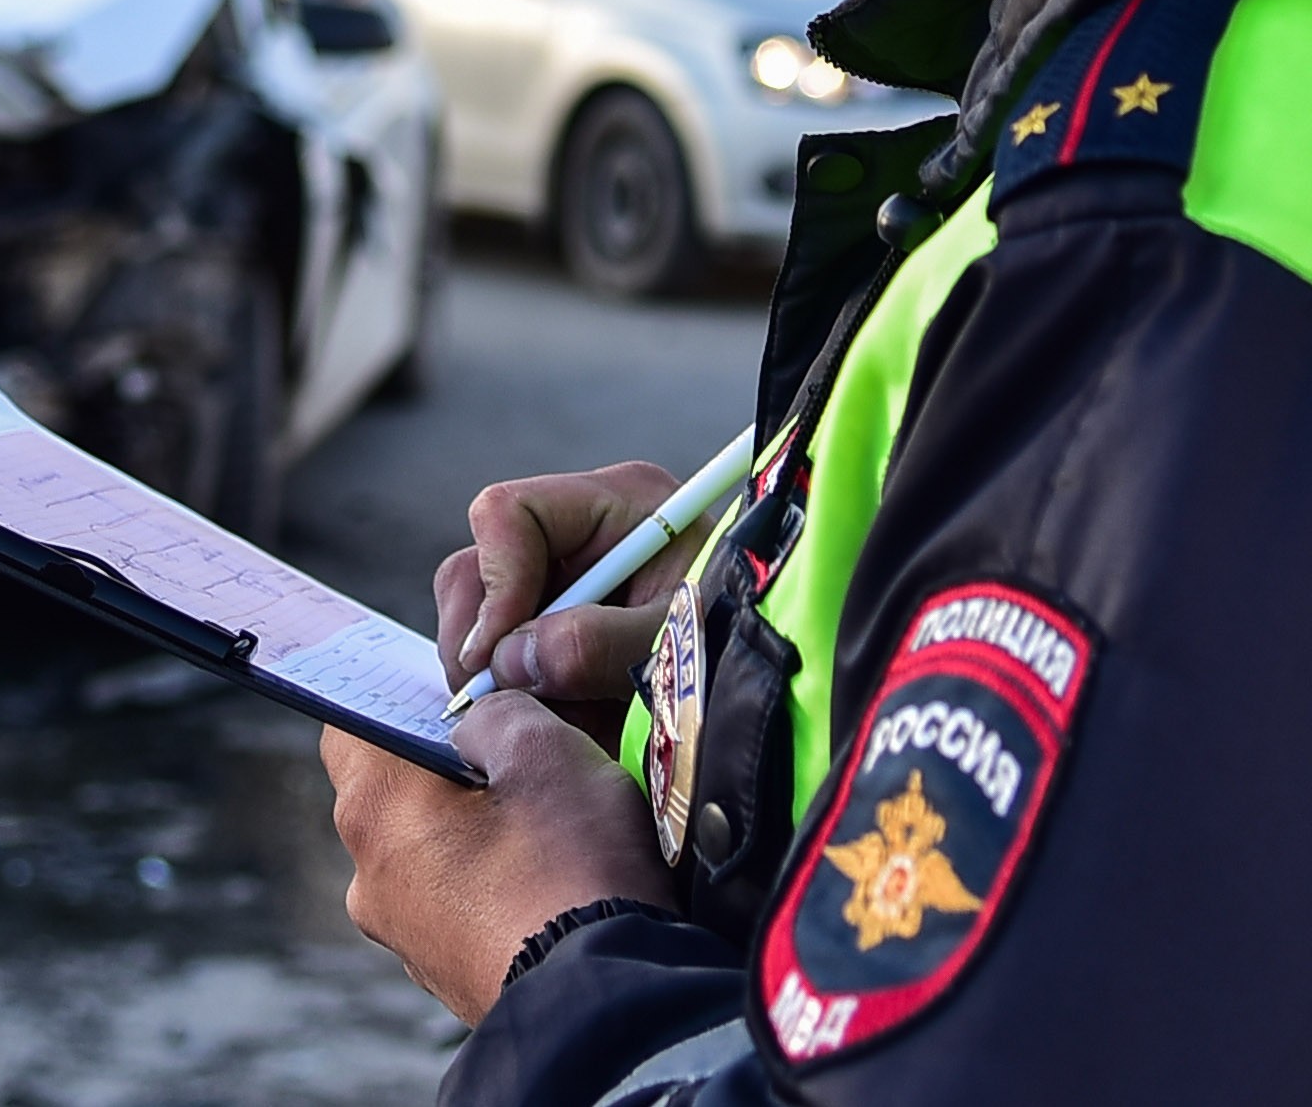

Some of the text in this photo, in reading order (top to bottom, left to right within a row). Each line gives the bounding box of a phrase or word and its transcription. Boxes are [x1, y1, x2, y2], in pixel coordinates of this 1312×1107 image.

[910, 597, 1076, 697] ПОЛИЦИЯ
[862, 701, 1022, 818] РОССИЯ
[769, 972, 858, 1057] МВД
